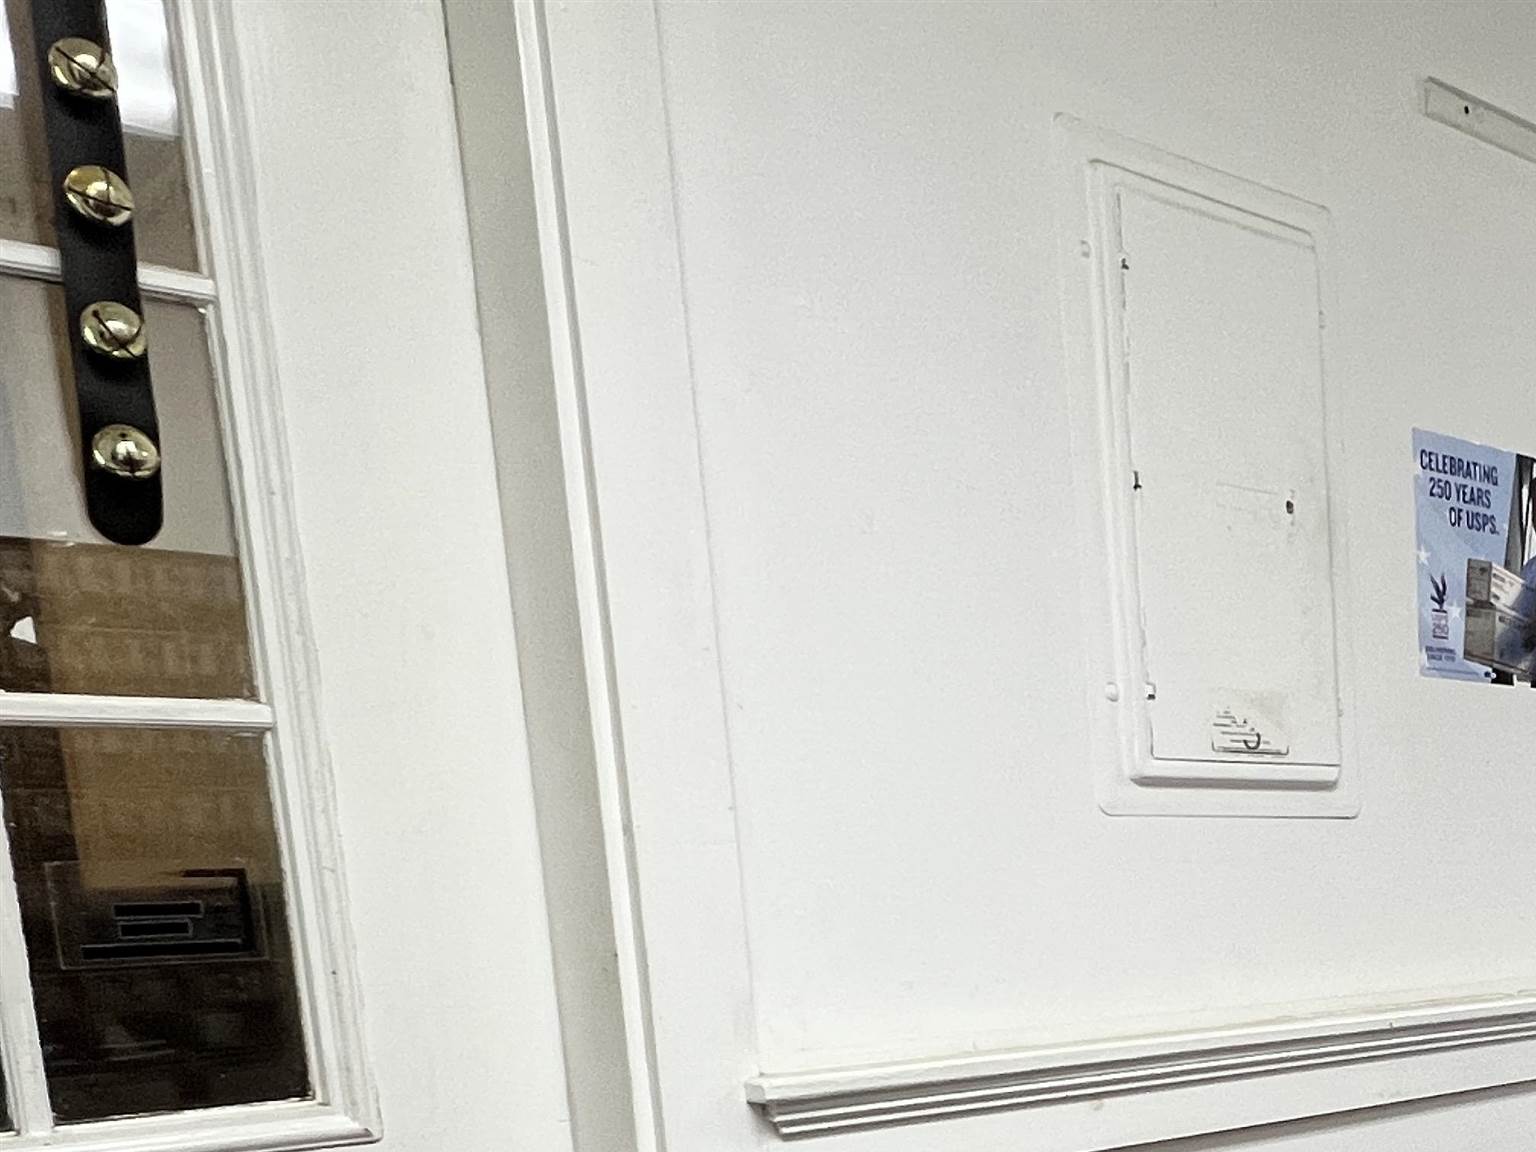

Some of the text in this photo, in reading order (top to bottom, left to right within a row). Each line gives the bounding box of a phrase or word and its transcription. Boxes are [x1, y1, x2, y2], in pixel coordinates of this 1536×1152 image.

[1420, 449, 1498, 486] CELEBRATING
[1429, 476, 1491, 509] 250 YEARS
[1449, 506, 1463, 527] OF
